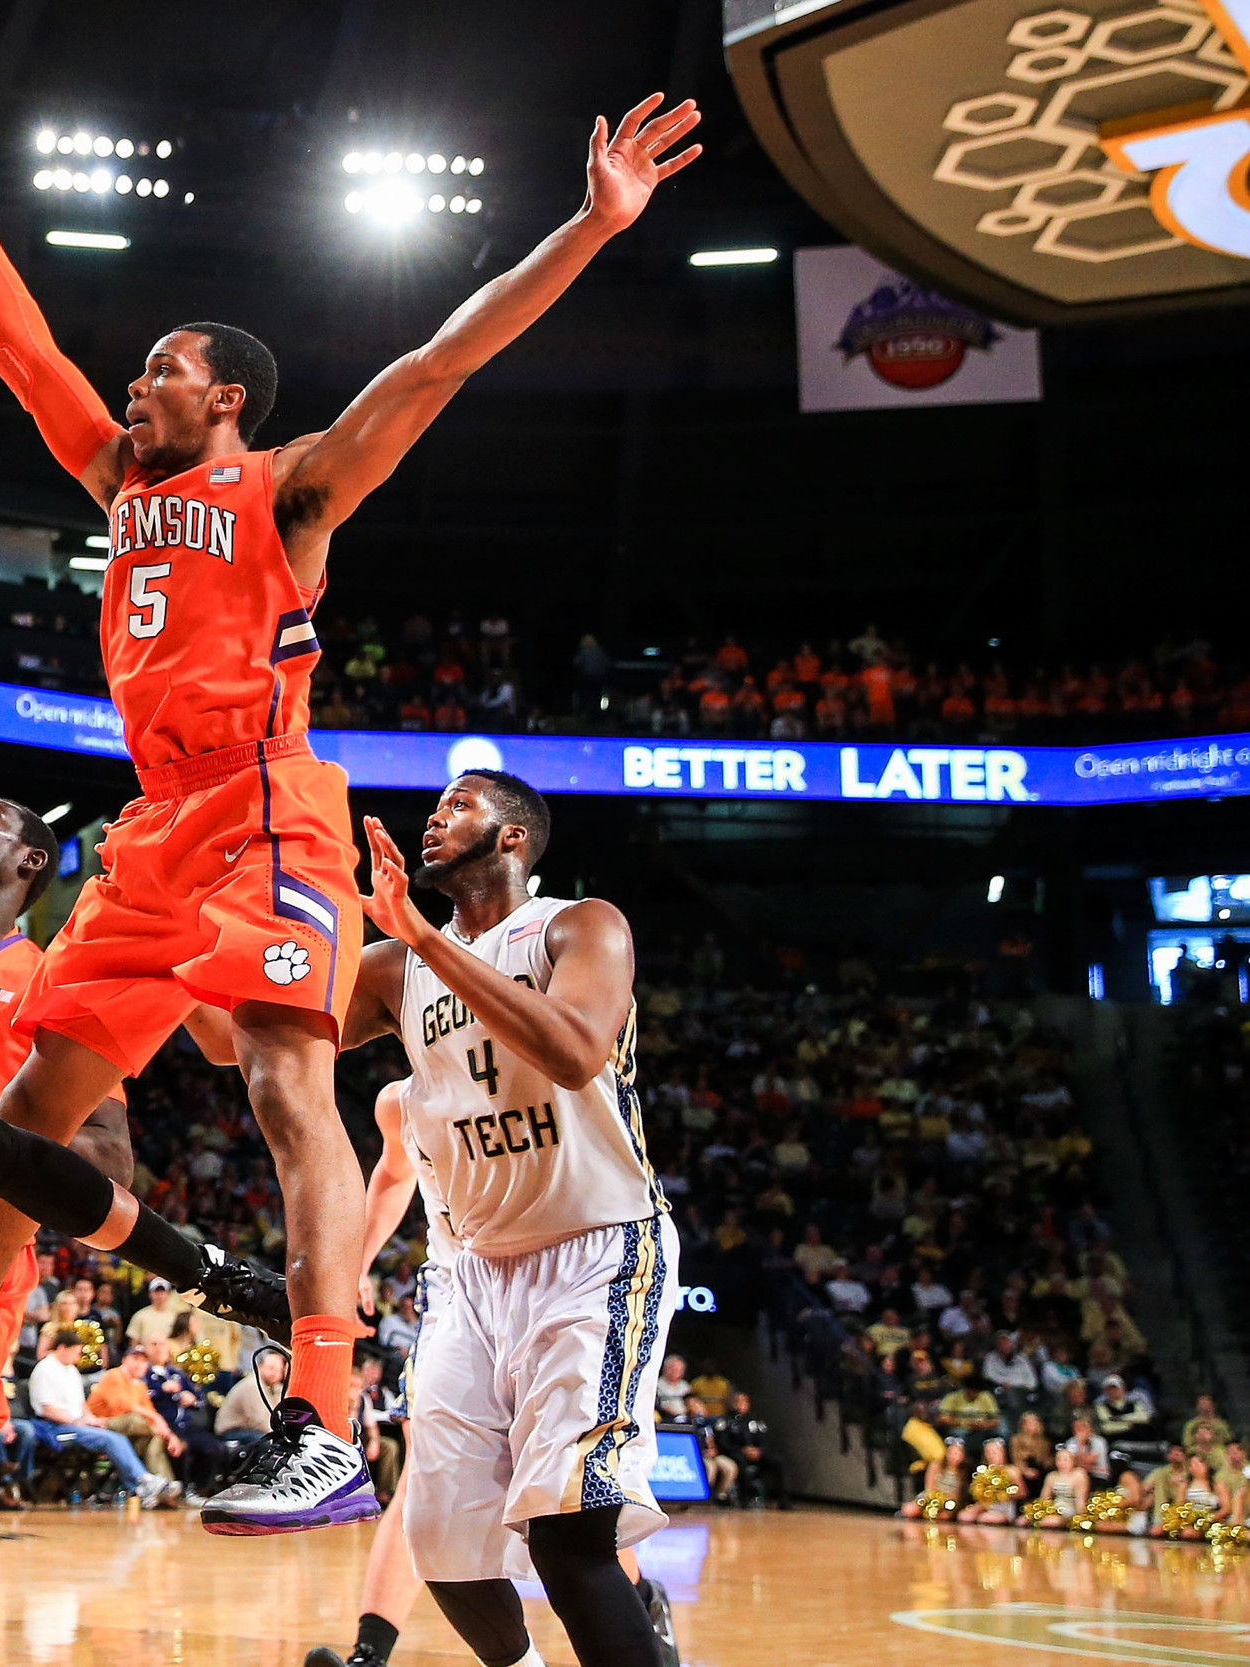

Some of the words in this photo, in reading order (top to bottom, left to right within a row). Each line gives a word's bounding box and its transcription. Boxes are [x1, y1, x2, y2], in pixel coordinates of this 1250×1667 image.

[128, 562, 171, 640] 5
[623, 745, 808, 791] BETTER
[466, 1037, 500, 1097] 4
[453, 1103, 560, 1161] TECH
